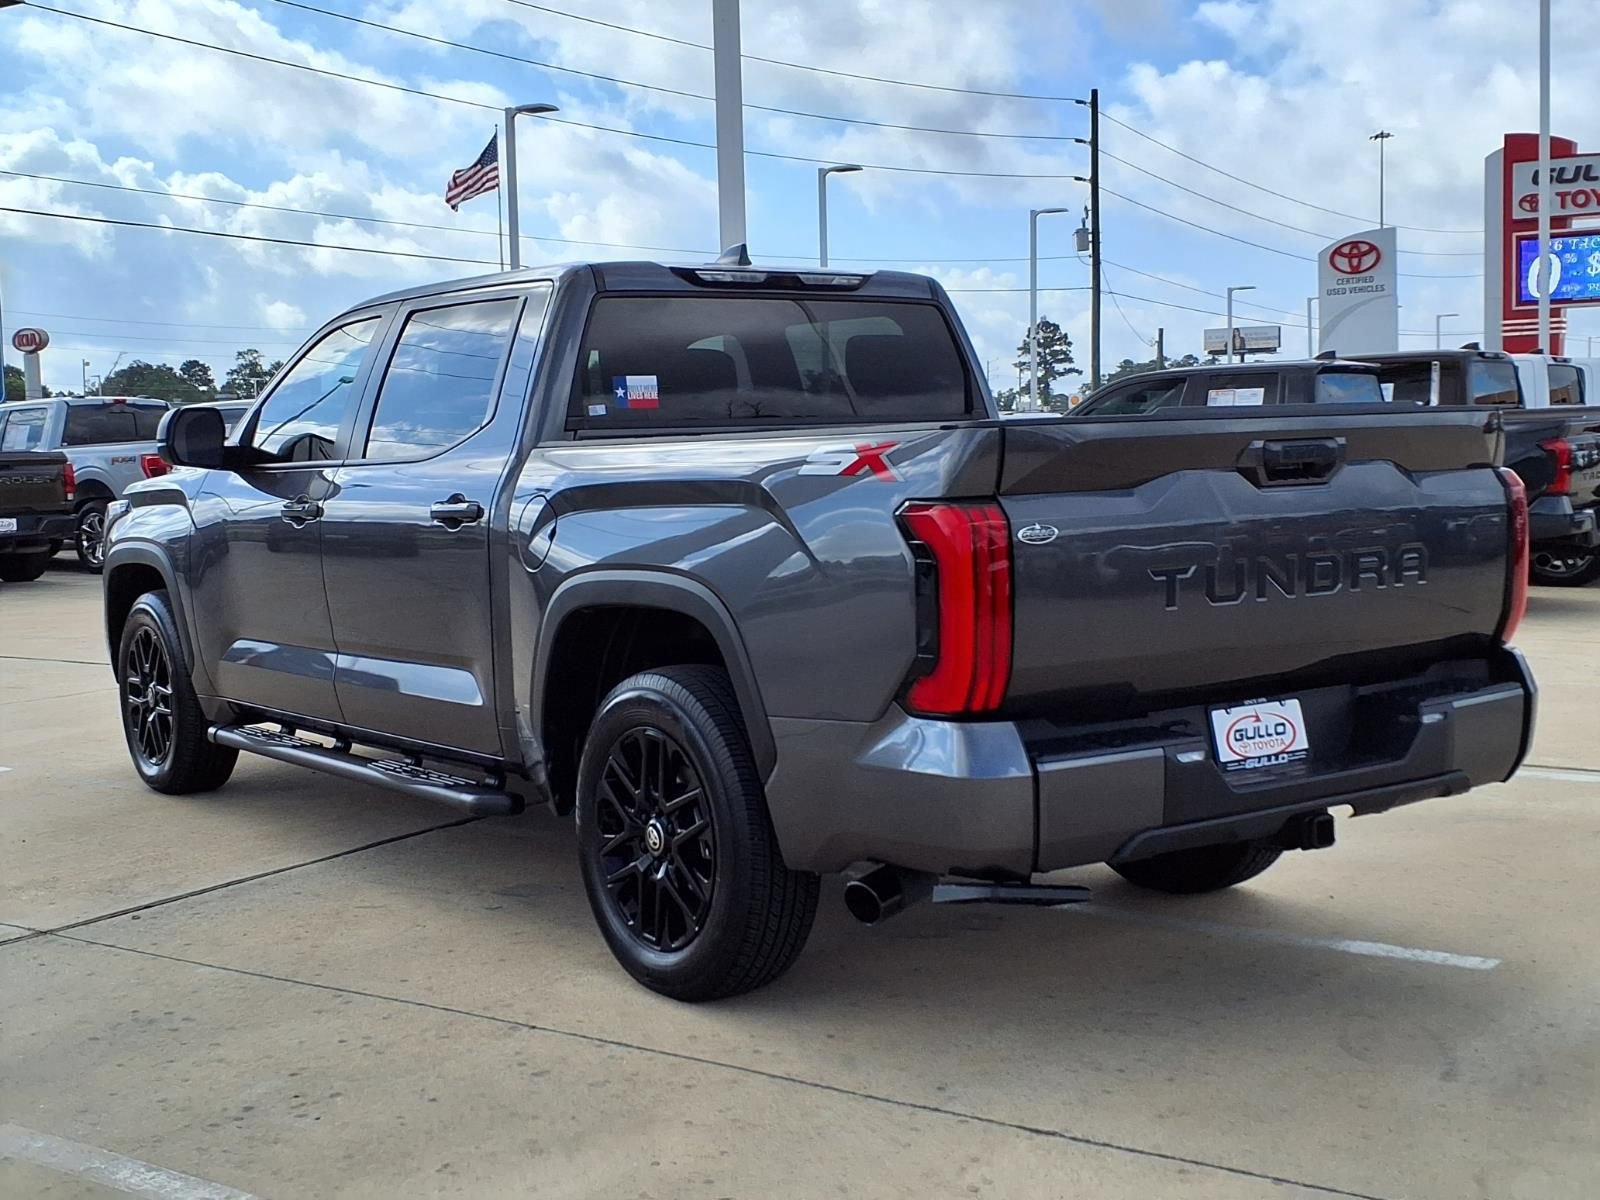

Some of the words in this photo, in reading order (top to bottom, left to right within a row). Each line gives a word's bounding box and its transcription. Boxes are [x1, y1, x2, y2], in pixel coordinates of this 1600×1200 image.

[1336, 275, 1375, 286] CERTIFIED
[1326, 287, 1347, 296] USED
[1349, 284, 1385, 294] VEHICLES
[17, 333, 40, 347] KIA
[644, 391, 658, 399] HERE
[1147, 542, 1429, 611] TUNDRA
[1233, 722, 1287, 742] GULLO
[1252, 737, 1287, 751] TOYOTA
[1245, 753, 1289, 769] GULLO
